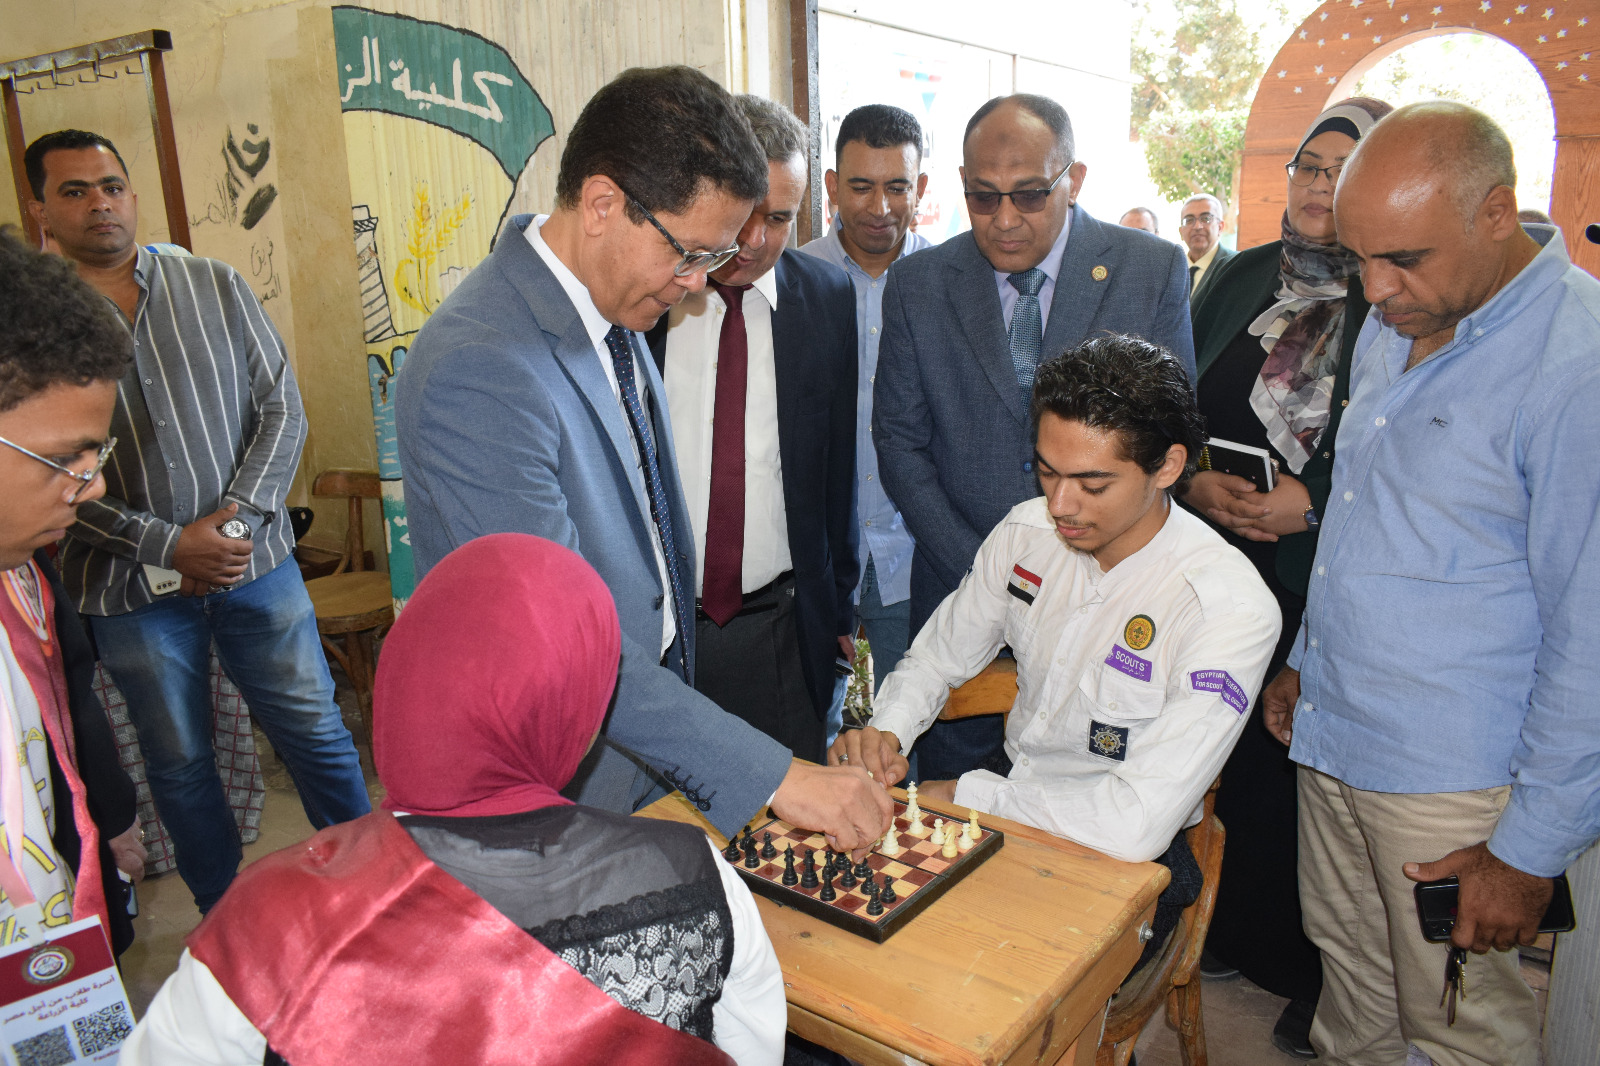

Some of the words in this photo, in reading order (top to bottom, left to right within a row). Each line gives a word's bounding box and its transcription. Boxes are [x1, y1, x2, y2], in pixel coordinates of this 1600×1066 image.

[341, 36, 381, 102] الز
[389, 58, 513, 123] كلية
[1115, 650, 1145, 672] SCOUTS
[1196, 671, 1226, 680] EGYPTIAN
[1205, 682, 1223, 690] SCOUT
[92, 974, 115, 990] أسرة
[65, 986, 91, 1000] طلاب
[28, 1000, 46, 1015] أجل
[48, 998, 63, 1008] من
[70, 997, 88, 1009] كلية
[3, 1011, 26, 1025] مصر
[37, 1005, 68, 1021] الزراعة
